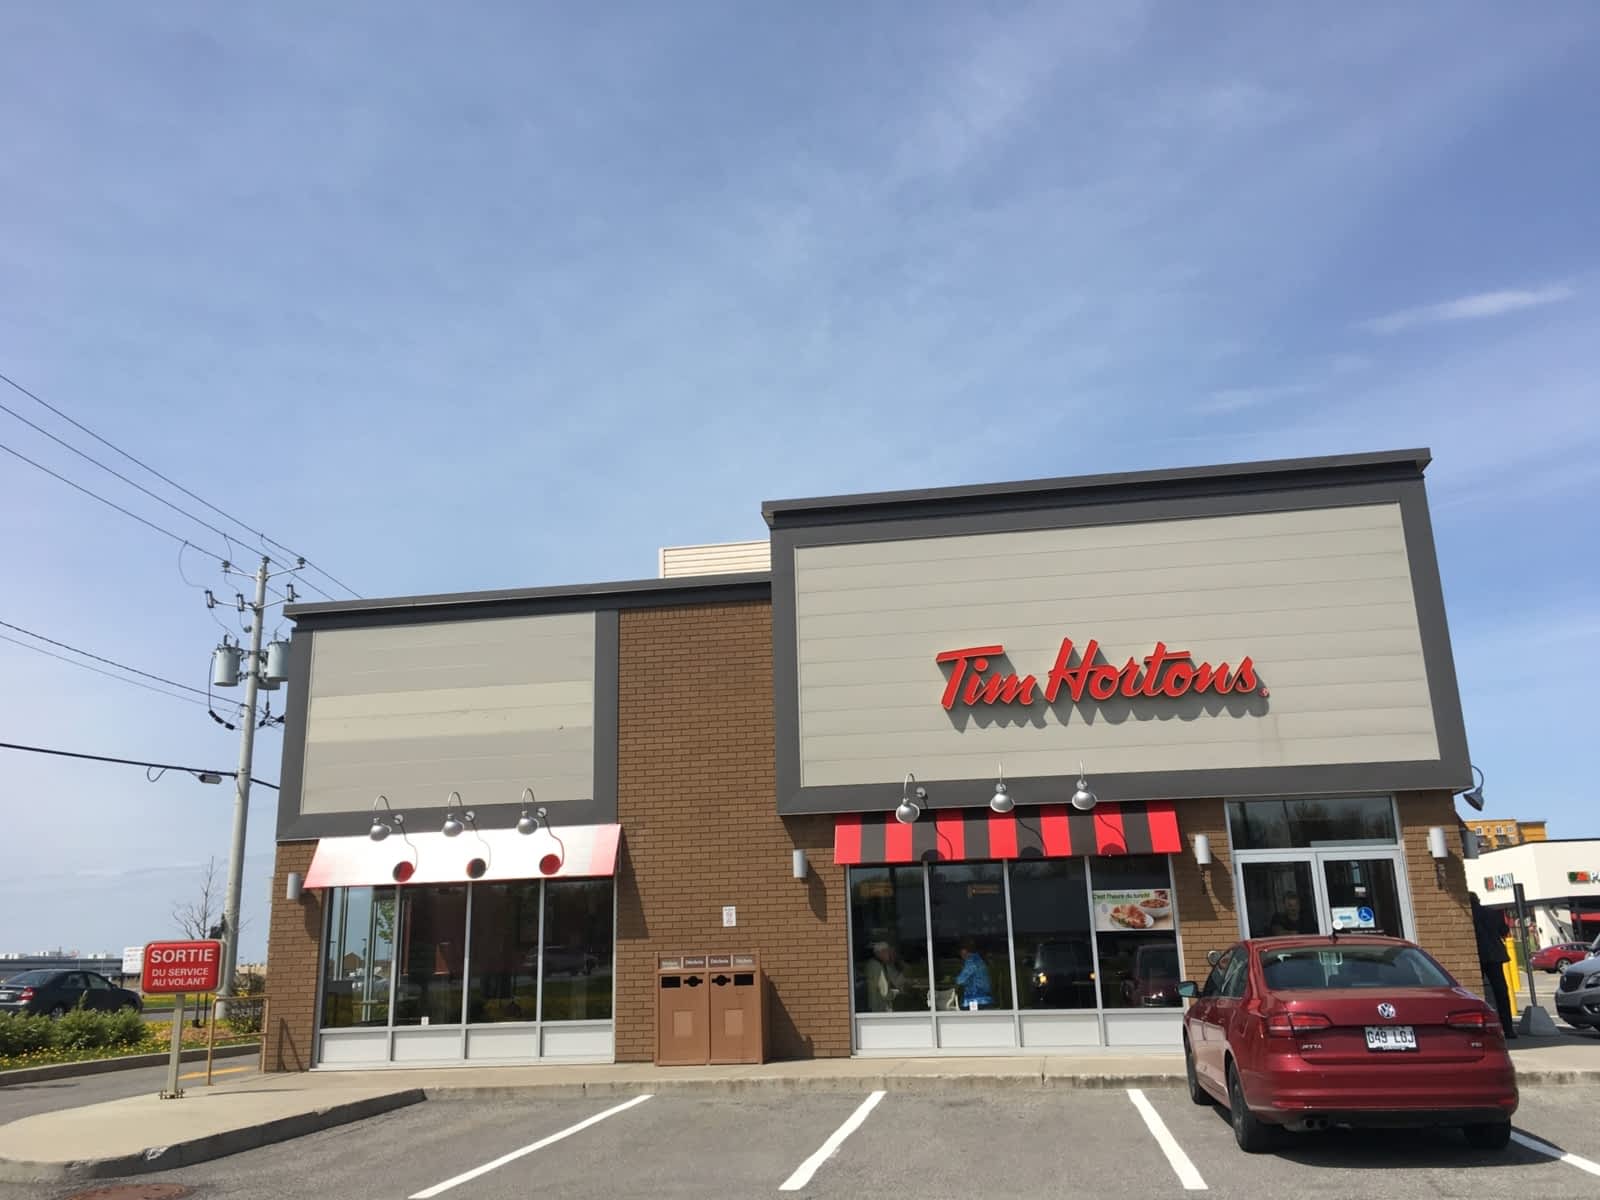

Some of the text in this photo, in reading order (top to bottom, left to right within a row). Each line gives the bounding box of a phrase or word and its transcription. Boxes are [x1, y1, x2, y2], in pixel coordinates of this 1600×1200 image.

[936, 645, 1037, 710] Tim
[151, 949, 214, 963] SORTIE
[151, 967, 209, 977] DU SERVICE
[151, 977, 207, 987] AU VOLANT
